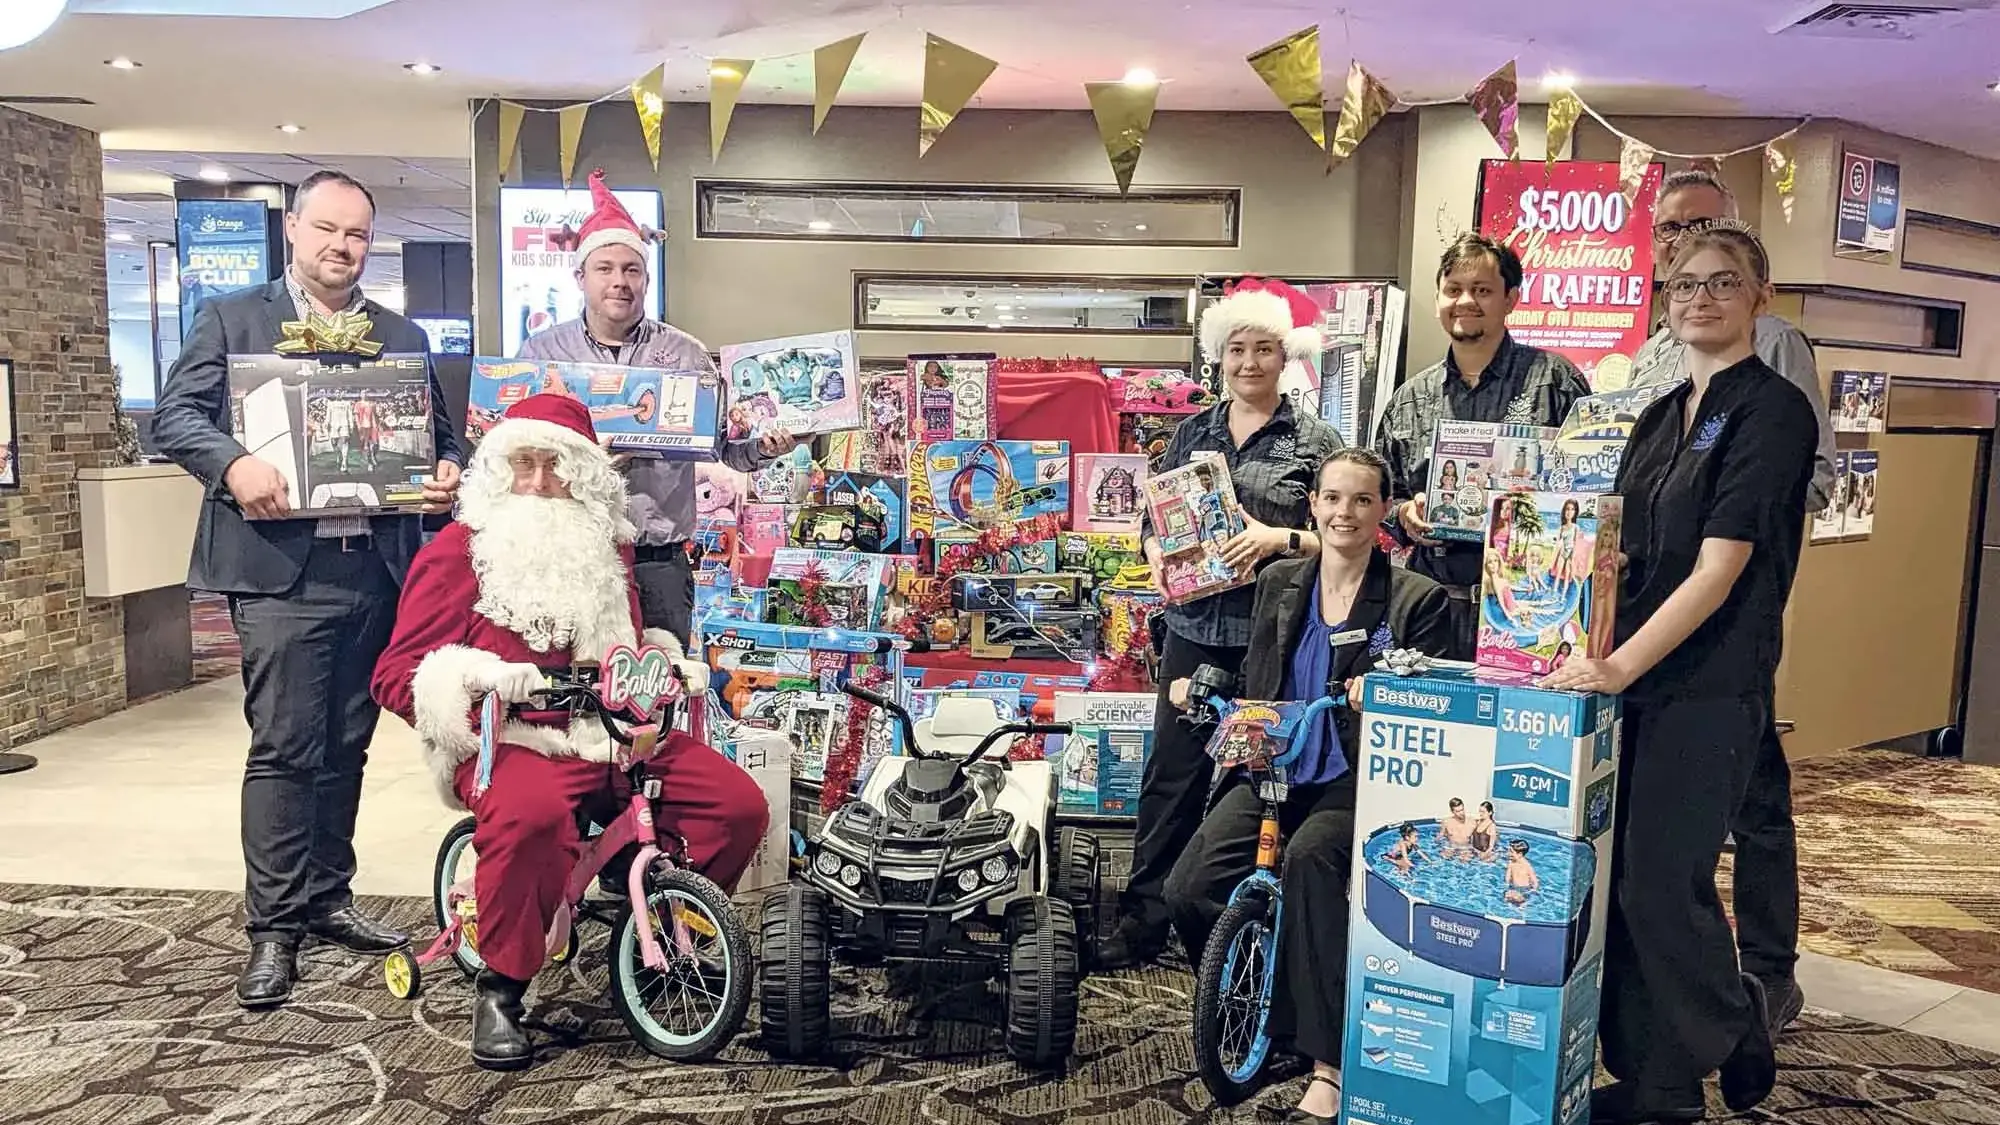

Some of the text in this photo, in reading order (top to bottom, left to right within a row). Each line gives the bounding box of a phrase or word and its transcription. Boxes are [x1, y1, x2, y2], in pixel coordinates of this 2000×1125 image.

[1517, 185, 1625, 234] $5,000
[1502, 226, 1635, 271] Christmas
[190, 253, 258, 269] BOWLS
[511, 253, 536, 267] KIDS
[538, 254, 564, 267] SOFT
[199, 271, 250, 284] CLUB
[1541, 274, 1644, 309] RAFFLE
[1125, 386, 1154, 400] Barbie
[648, 435, 693, 446] SCOOTER
[1444, 427, 1469, 436] make
[1477, 624, 1518, 650] Barbie
[817, 651, 849, 660] FAST
[823, 660, 846, 669] FILL
[607, 653, 681, 704] Barbie
[1092, 700, 1147, 710] unbelievable
[1375, 684, 1450, 713] Bestway
[1501, 707, 1570, 738] 3.66 M
[1370, 720, 1452, 757] STEEL
[1369, 753, 1424, 788] PRO
[1511, 773, 1551, 792] 76 CM
[1430, 915, 1481, 939] Bestway
[1435, 931, 1473, 948] STEEL PRO
[1374, 983, 1446, 1004] PROVEN PERFORMANCE
[1354, 1096, 1372, 1109] POOL
